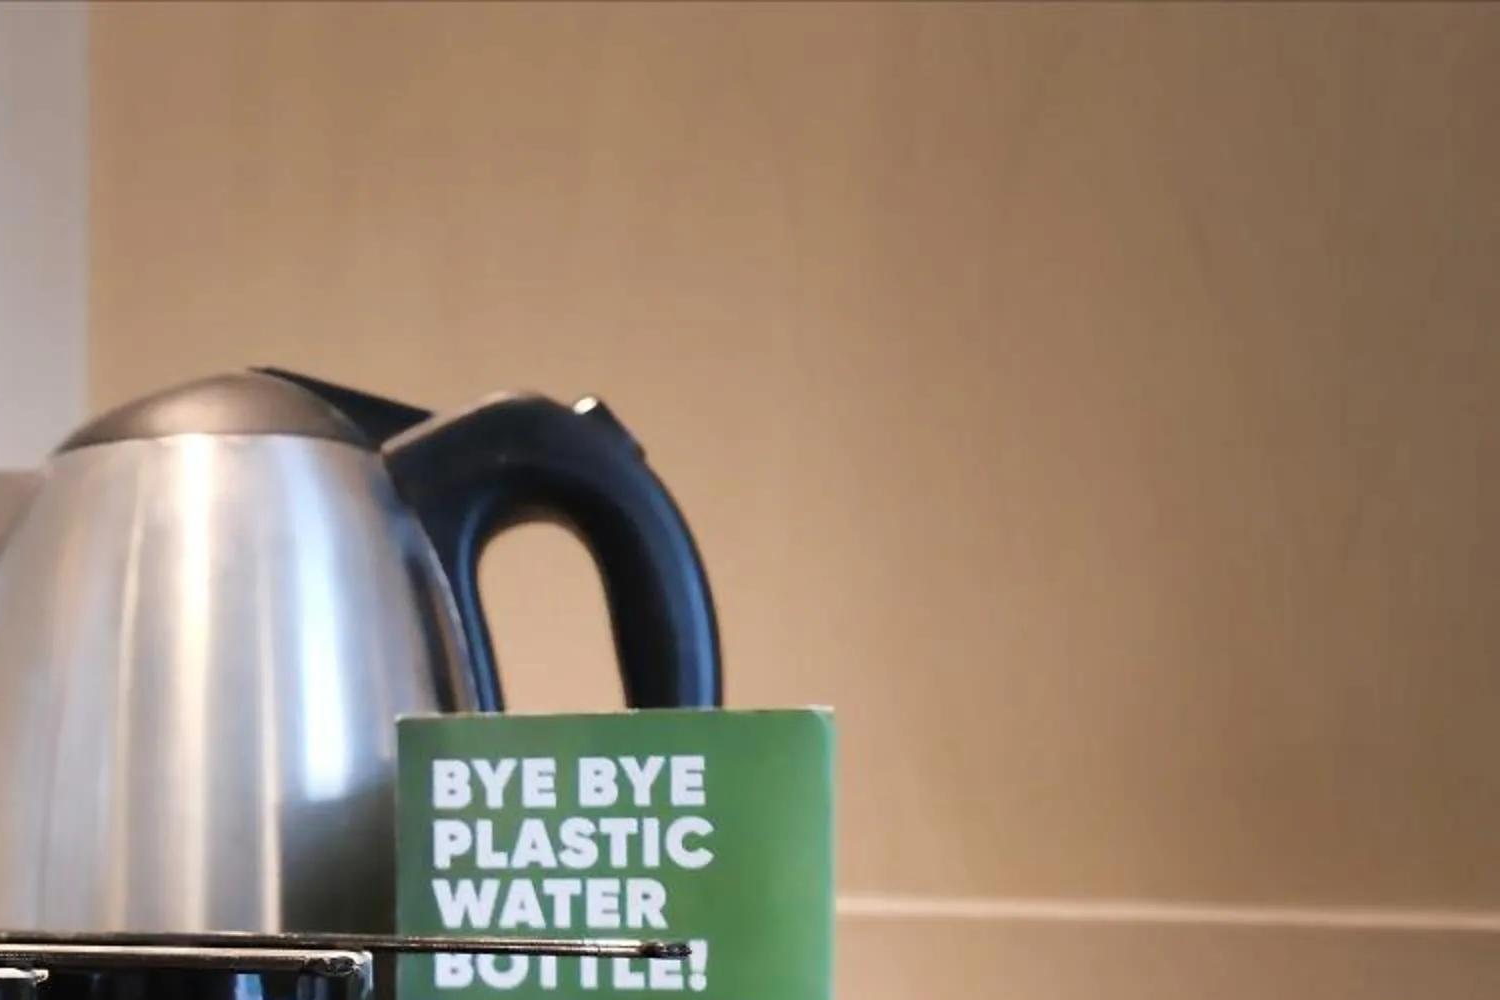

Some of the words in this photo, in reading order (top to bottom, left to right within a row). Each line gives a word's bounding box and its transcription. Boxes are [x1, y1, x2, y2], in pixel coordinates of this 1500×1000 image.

[432, 757, 557, 809] BYE
[578, 755, 706, 807] BYE
[432, 816, 714, 869] PLASTIC
[431, 878, 668, 928] WATER
[434, 939, 708, 991] BOTTLE!
